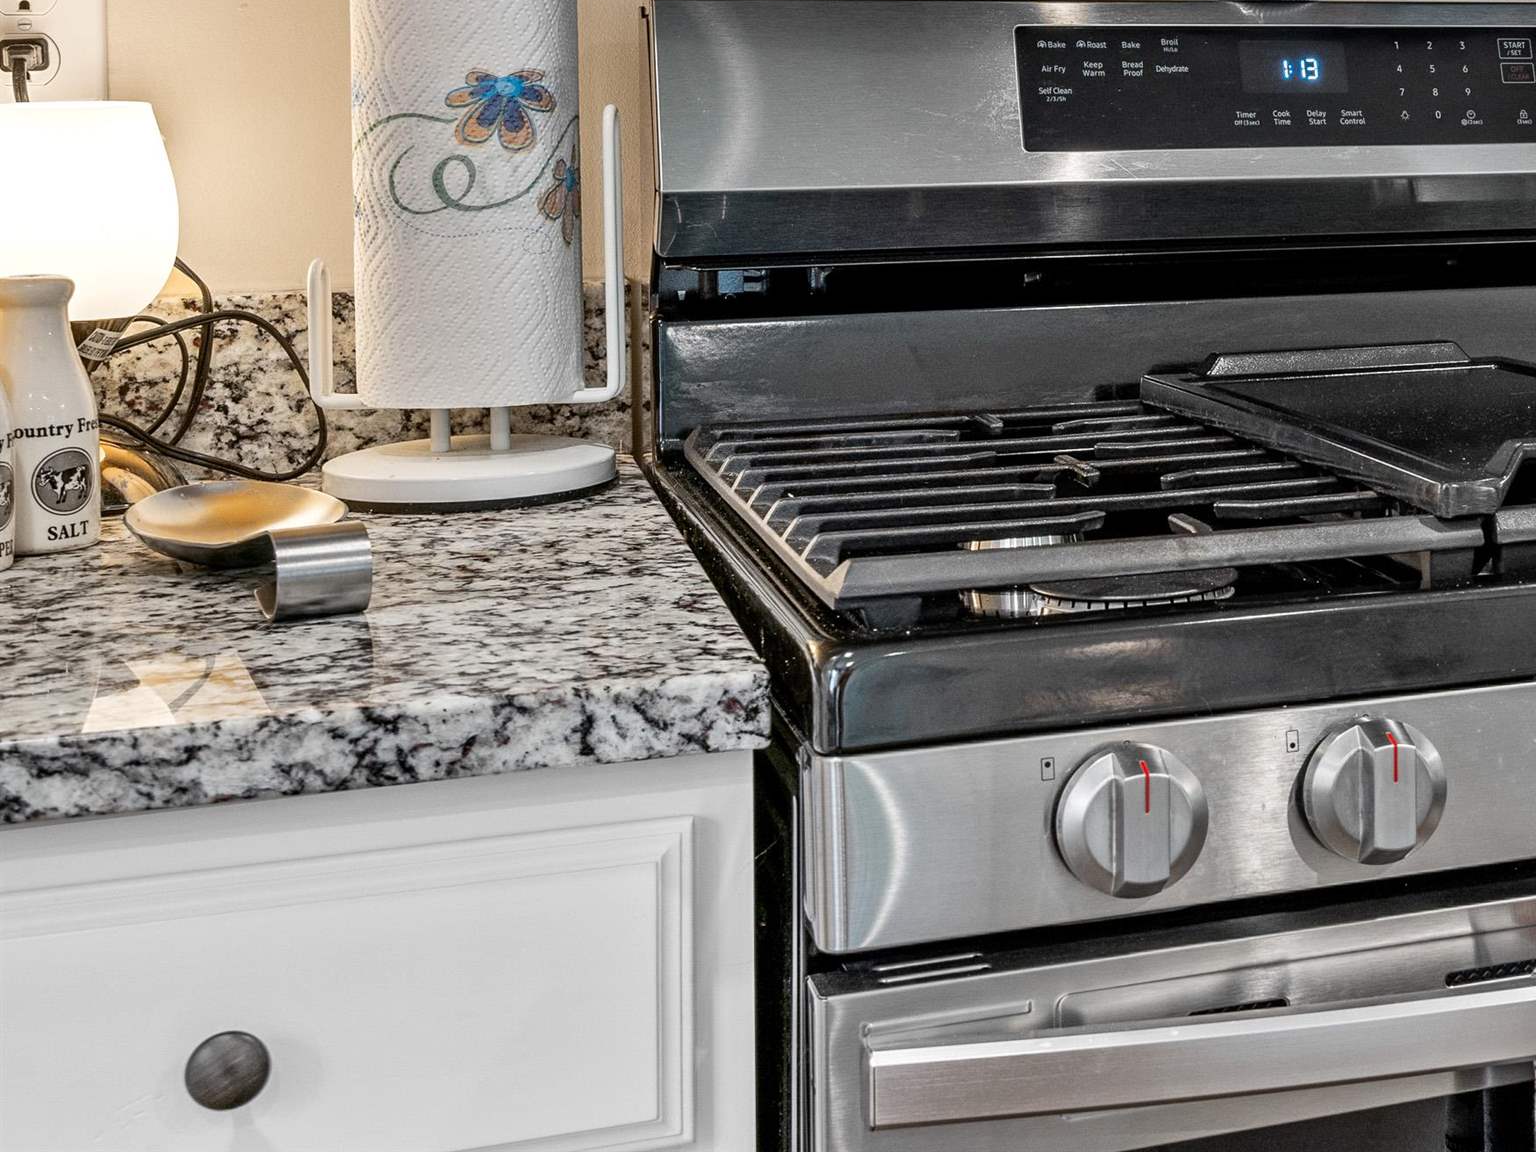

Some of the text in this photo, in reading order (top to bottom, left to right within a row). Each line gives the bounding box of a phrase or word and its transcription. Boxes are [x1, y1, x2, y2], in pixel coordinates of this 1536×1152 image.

[1047, 41, 1066, 49] Bake
[1087, 41, 1107, 49] Roast
[1121, 41, 1141, 49] Bake
[1160, 38, 1178, 46] Broil
[1394, 41, 1399, 50] 1
[1426, 41, 1432, 50] 2
[1459, 41, 1465, 50] 3
[1503, 41, 1526, 49] START
[1041, 65, 1066, 74] Air Fry
[1083, 61, 1103, 70] Keep
[1121, 61, 1144, 69] Bread
[1155, 65, 1190, 74] Dehydrate
[1281, 57, 1319, 81] 1:13
[1396, 64, 1402, 73] 4
[1429, 64, 1435, 73] 5
[1462, 64, 1468, 73] 6
[1082, 69, 1106, 77] Warm
[1123, 69, 1143, 77] Proof
[1038, 87, 1073, 95] Self Clean
[1399, 87, 1405, 96] 7
[1432, 87, 1439, 96] 8
[1465, 87, 1471, 96] 9
[1236, 111, 1257, 119] Timer
[1272, 110, 1290, 118] Cook
[1306, 110, 1327, 120] Delay
[1340, 110, 1363, 118] Smart
[1435, 111, 1441, 120] 0
[1273, 118, 1291, 126] Time
[1308, 118, 1327, 126] Start
[1339, 118, 1366, 126] Control
[14, 423, 74, 439] ountry
[47, 520, 89, 541] SALT
